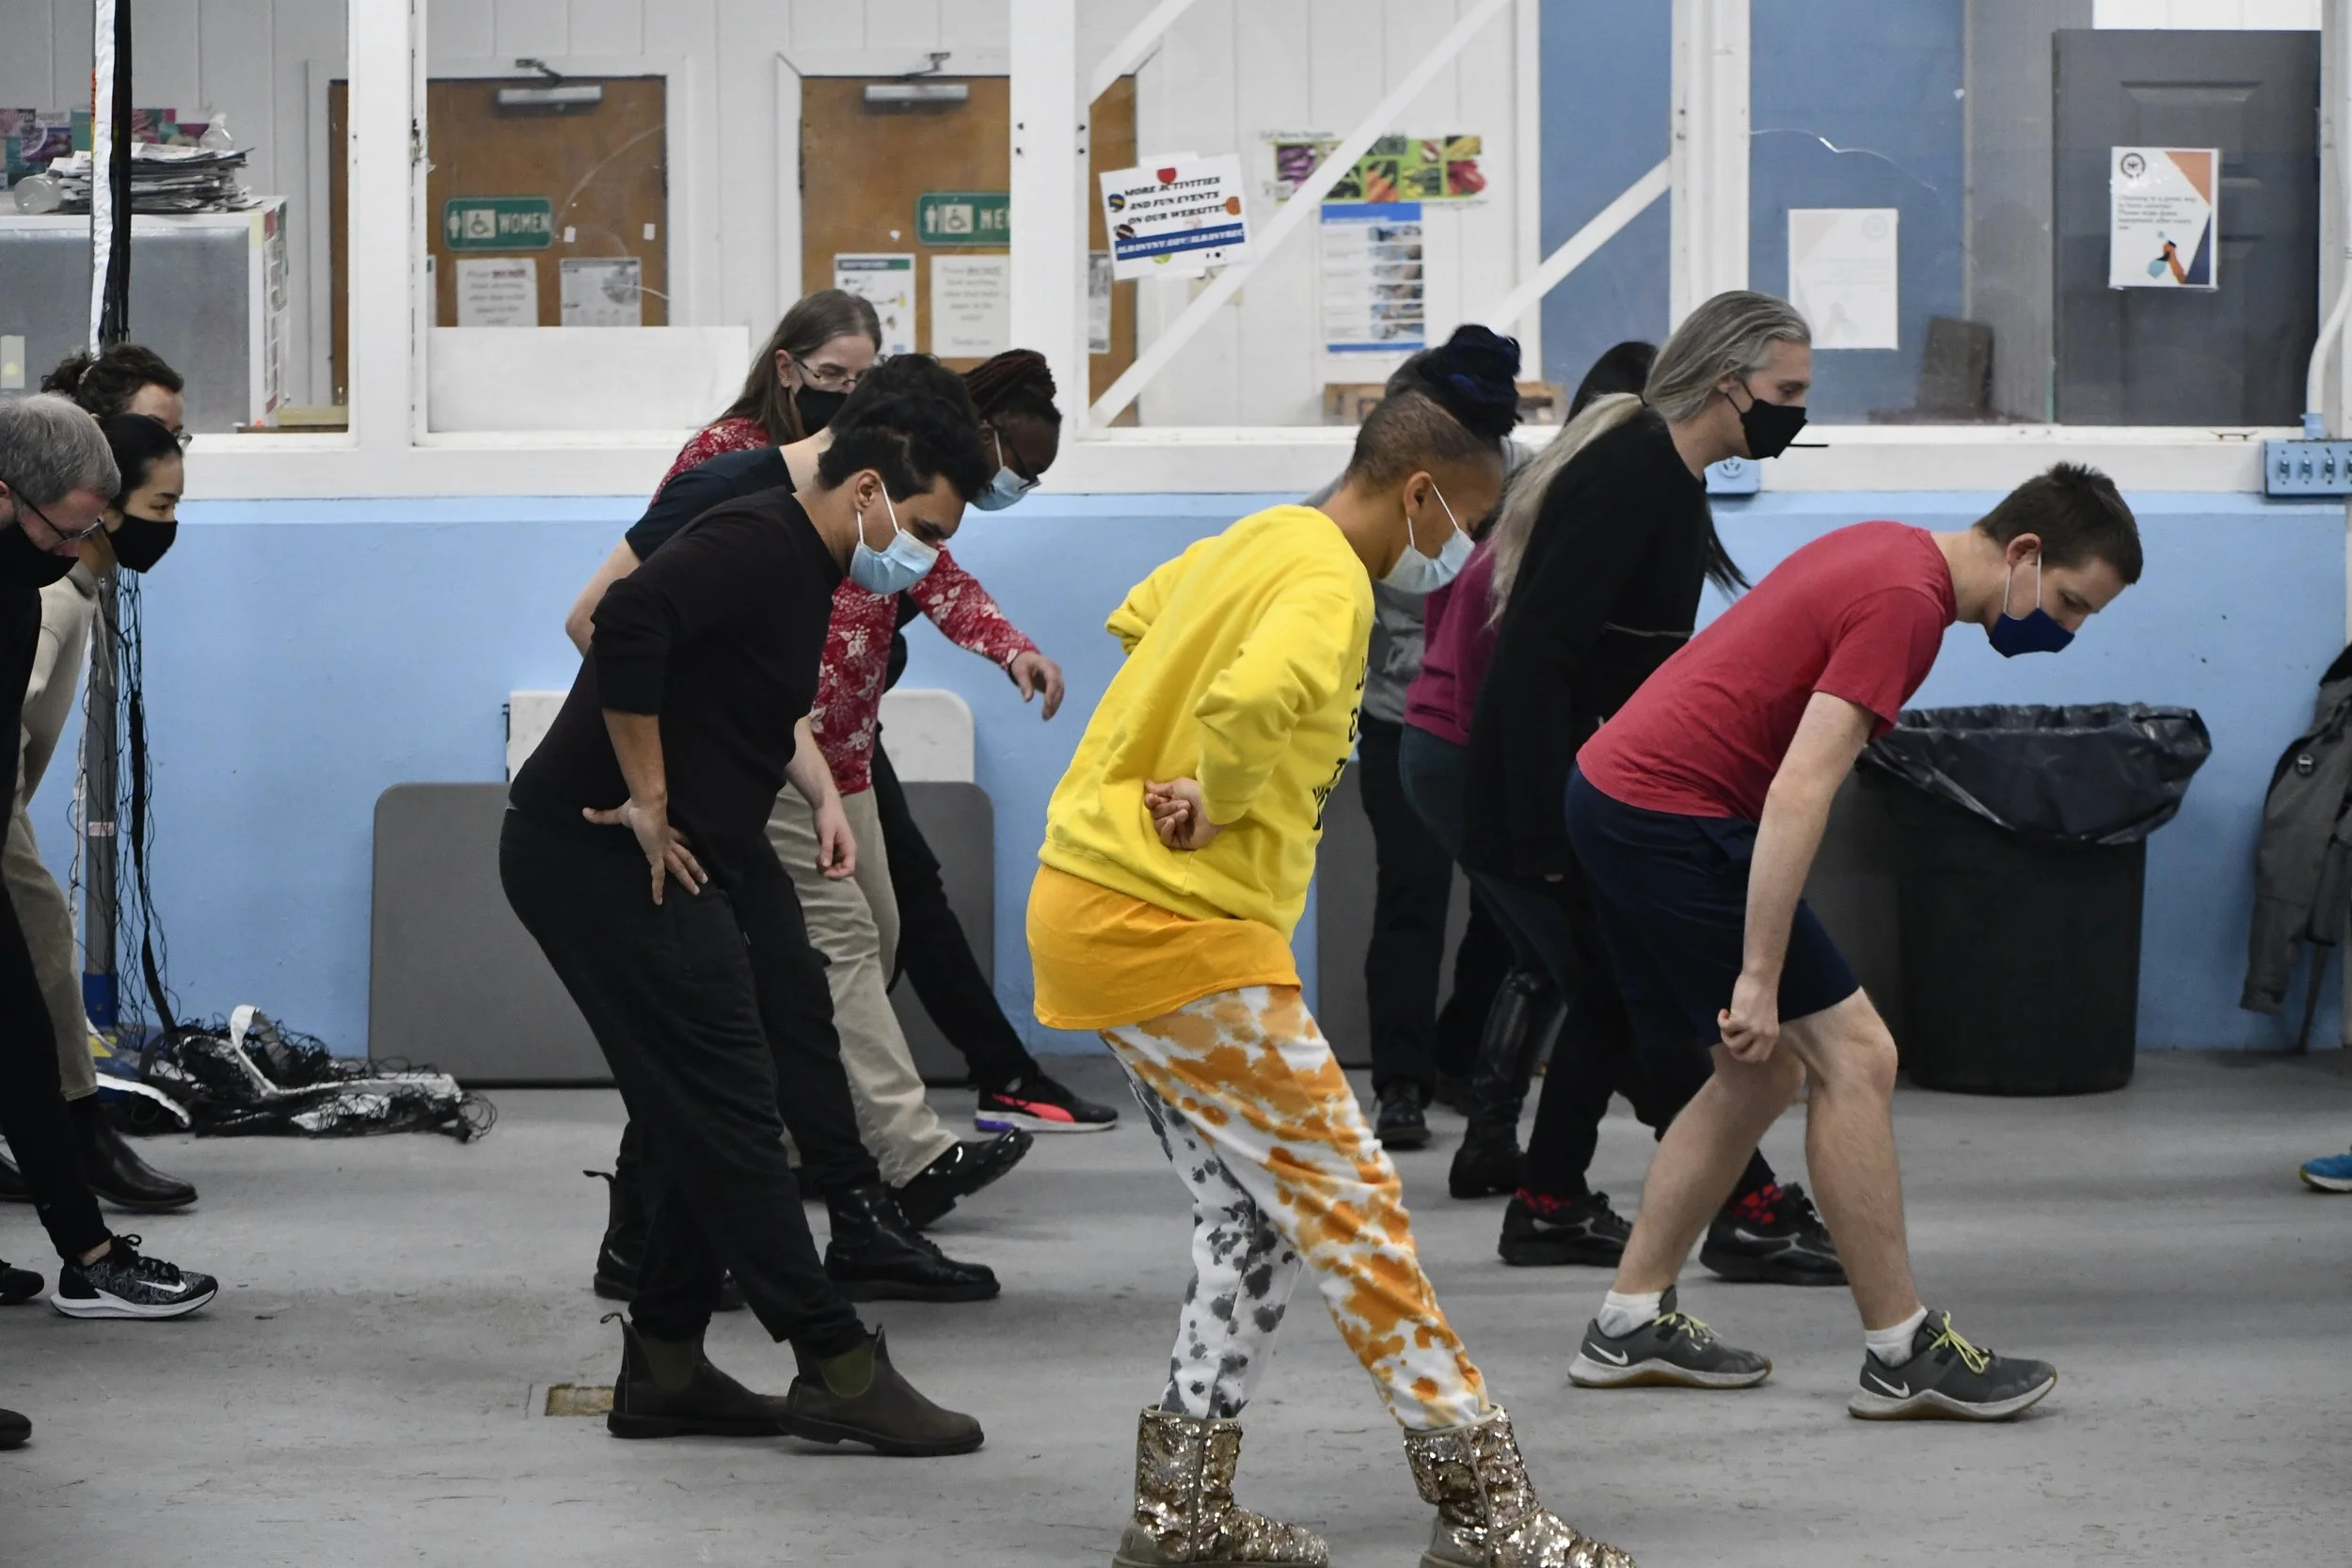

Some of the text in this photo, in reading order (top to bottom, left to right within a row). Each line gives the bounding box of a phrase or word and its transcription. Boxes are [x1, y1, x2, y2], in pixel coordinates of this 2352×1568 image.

[1124, 176, 1221, 198] MORE ACTIVITIES
[1130, 191, 1220, 211] AND FUN EVENTS
[498, 213, 550, 234] WOMEN
[979, 208, 1010, 230] ME
[1127, 216, 1142, 226] ON
[1145, 212, 1168, 224] OUR
